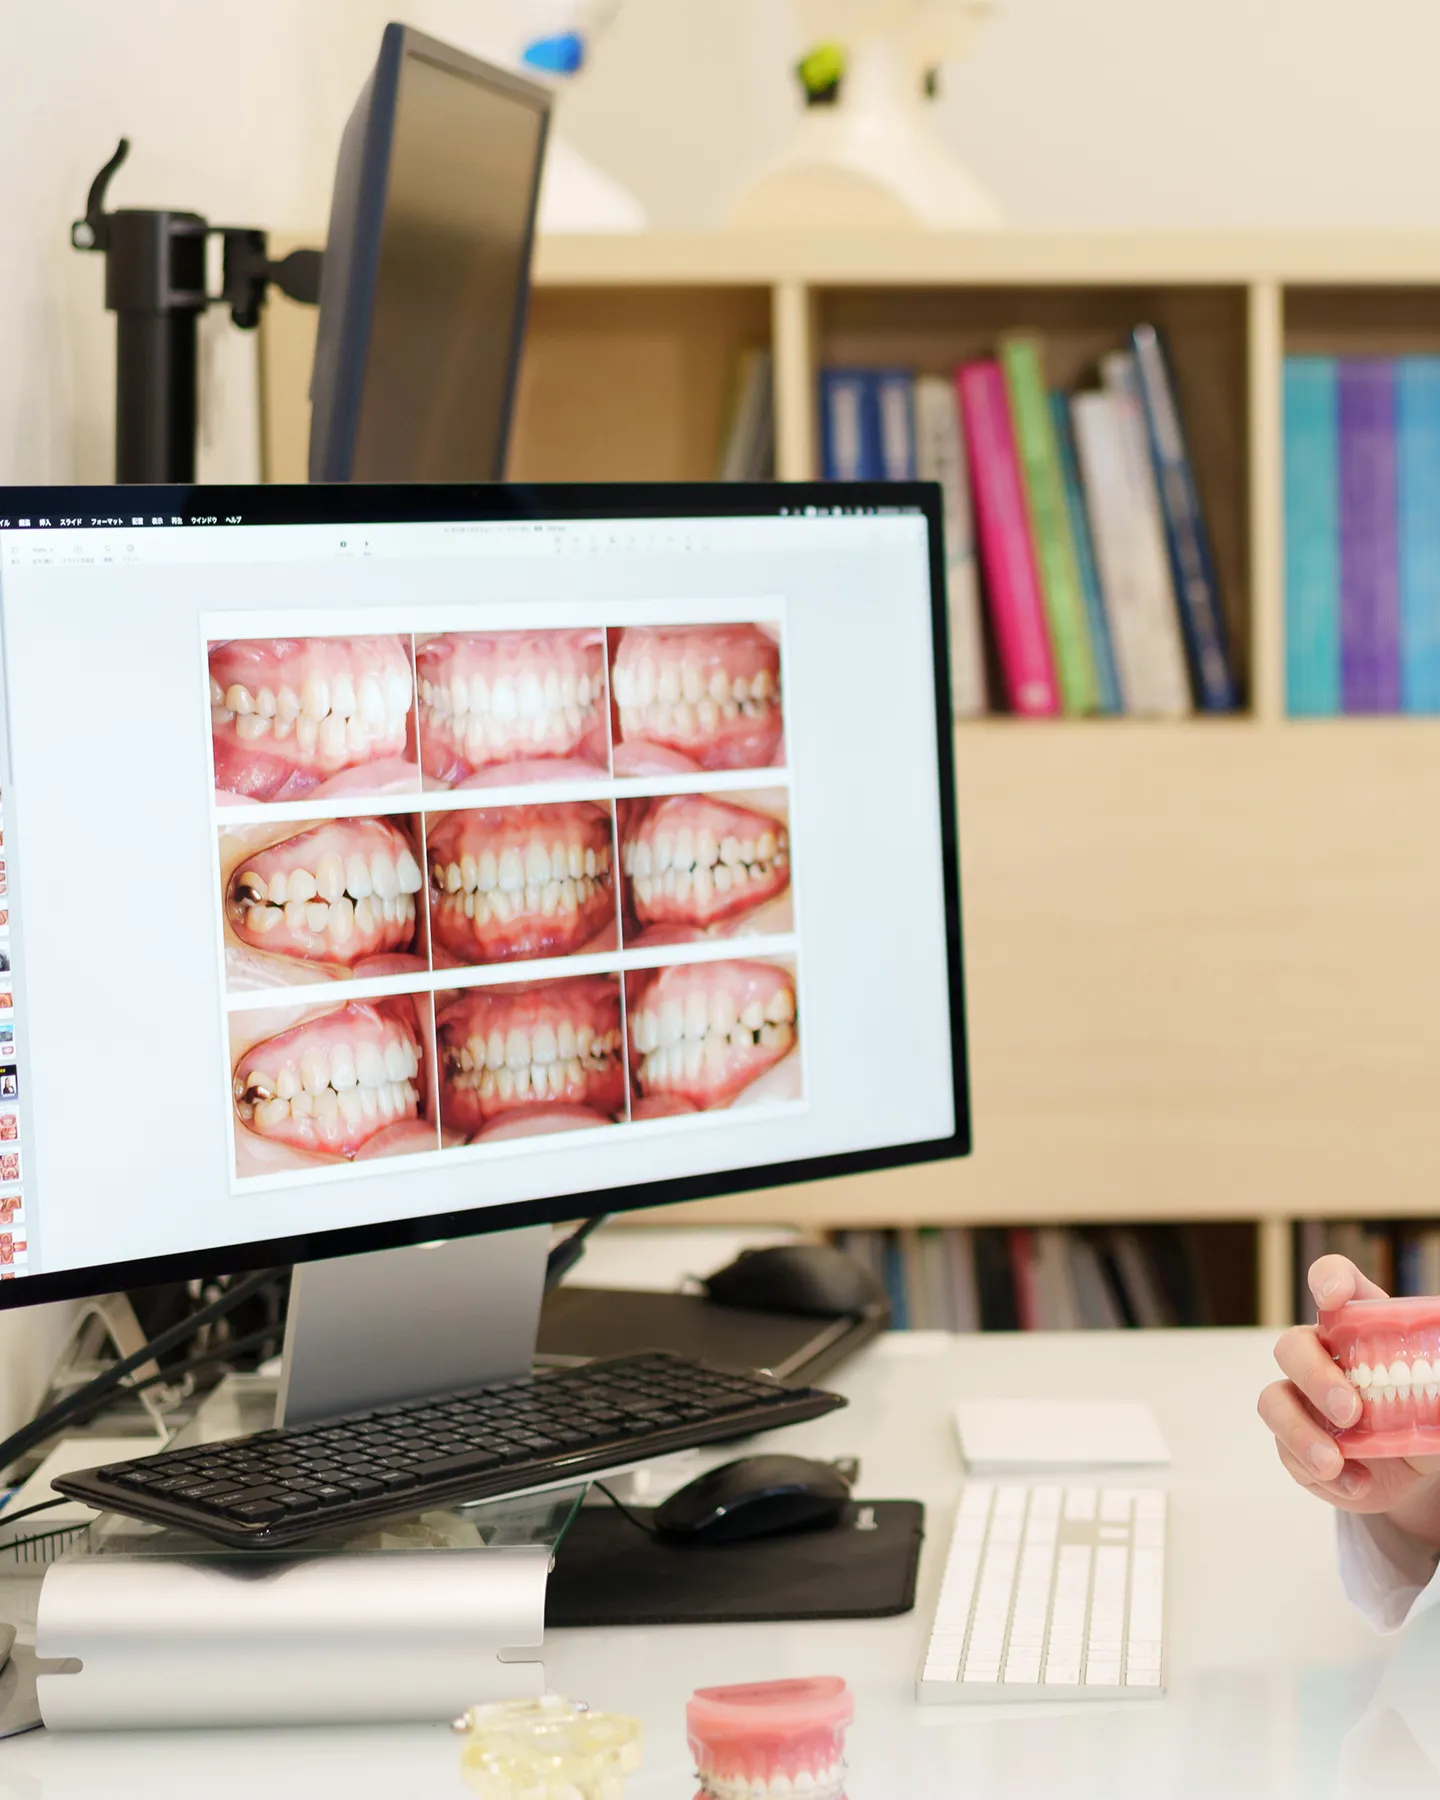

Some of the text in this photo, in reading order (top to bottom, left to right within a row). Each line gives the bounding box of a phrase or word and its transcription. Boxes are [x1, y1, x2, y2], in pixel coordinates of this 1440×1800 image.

[60, 518, 82, 526] スライド
[91, 518, 123, 526] フォーマット
[191, 516, 217, 524] ウインドウ
[225, 515, 242, 524] ヘルプ
